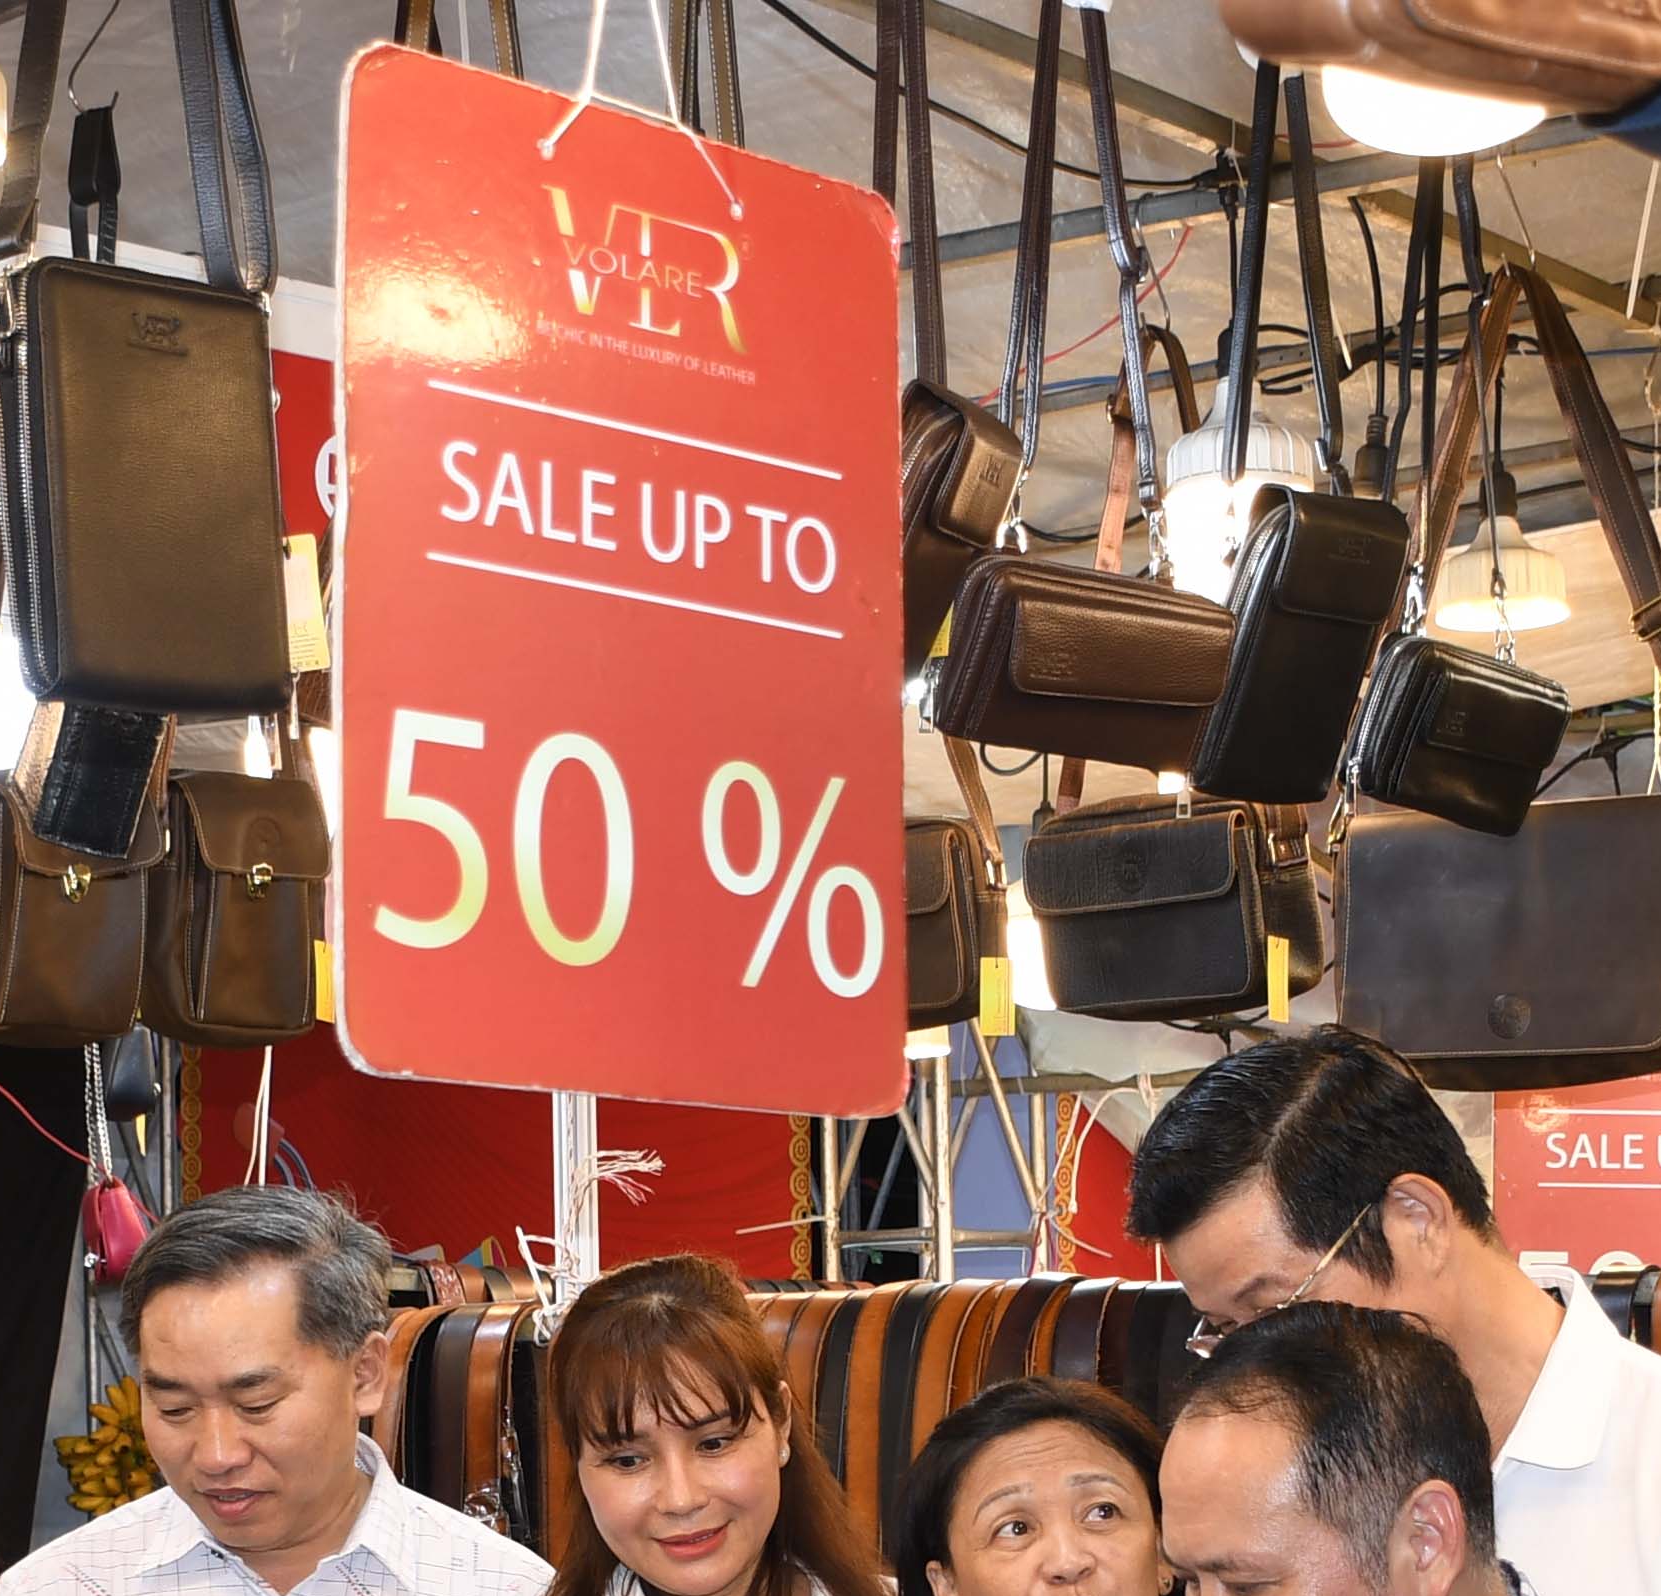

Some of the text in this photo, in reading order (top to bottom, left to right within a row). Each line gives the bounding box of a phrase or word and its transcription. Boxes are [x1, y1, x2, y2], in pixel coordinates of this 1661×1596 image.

[562, 238, 703, 299] VOLARE
[589, 331, 604, 349] IN
[606, 334, 629, 355] THE
[631, 341, 682, 367] LUXURY
[683, 353, 700, 371] OF
[702, 359, 757, 386] LEATHER
[439, 440, 618, 552] SALE
[640, 481, 732, 570] UP
[744, 504, 838, 594] TO
[373, 707, 885, 1000] 50 %
[1545, 1132, 1644, 1170] SALE
